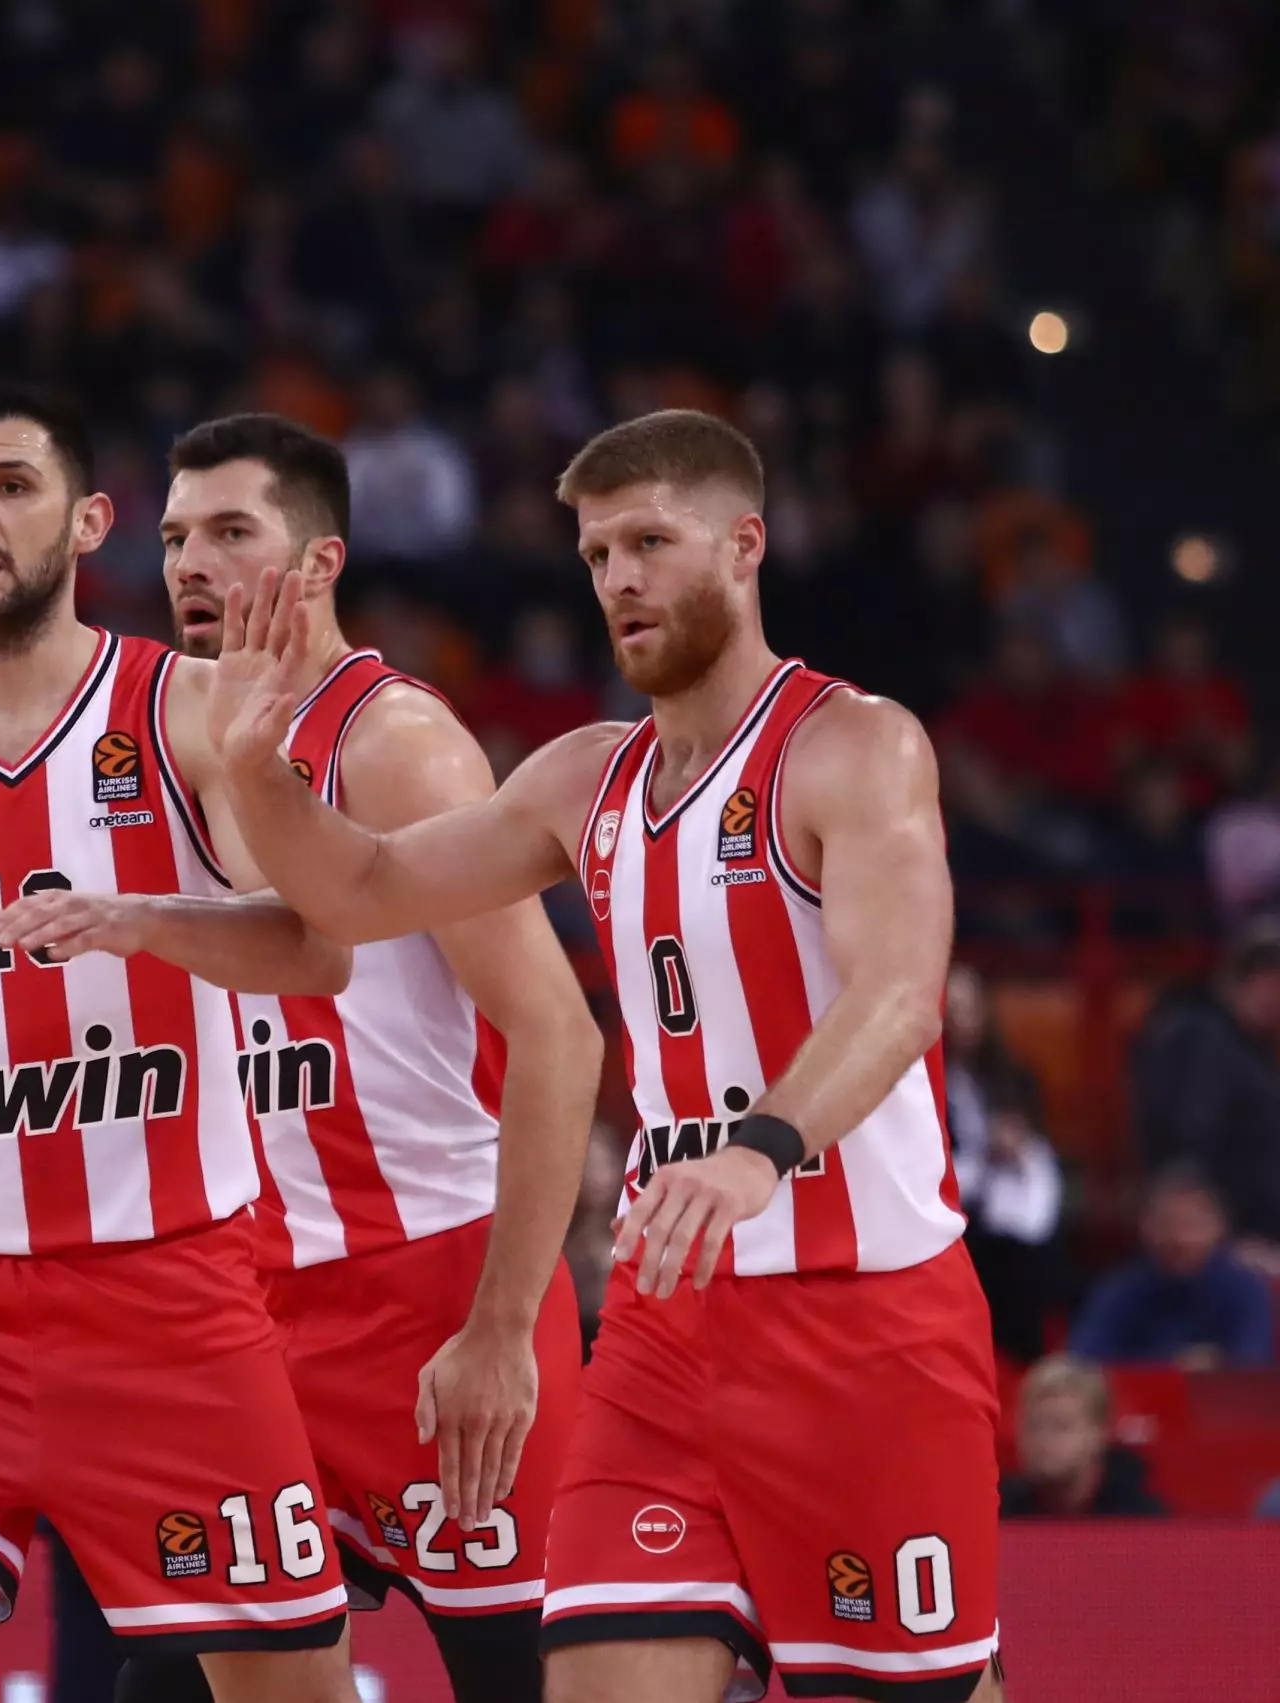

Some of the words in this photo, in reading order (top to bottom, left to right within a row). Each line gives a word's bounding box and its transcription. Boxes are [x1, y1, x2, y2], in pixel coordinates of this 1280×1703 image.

[98, 776, 137, 786] TURKISH
[98, 783, 138, 793] AIRLINES
[98, 791, 138, 800] EuroLeague
[89, 812, 152, 828] oneteam
[711, 870, 765, 886] oneteam
[648, 935, 700, 1036] 0
[237, 1017, 336, 1118] in
[219, 1480, 326, 1585] 16
[637, 1523, 681, 1532] GSA
[166, 1553, 206, 1564] TURKISH
[166, 1560, 207, 1571] AIRLINES
[894, 1533, 957, 1637] 0
